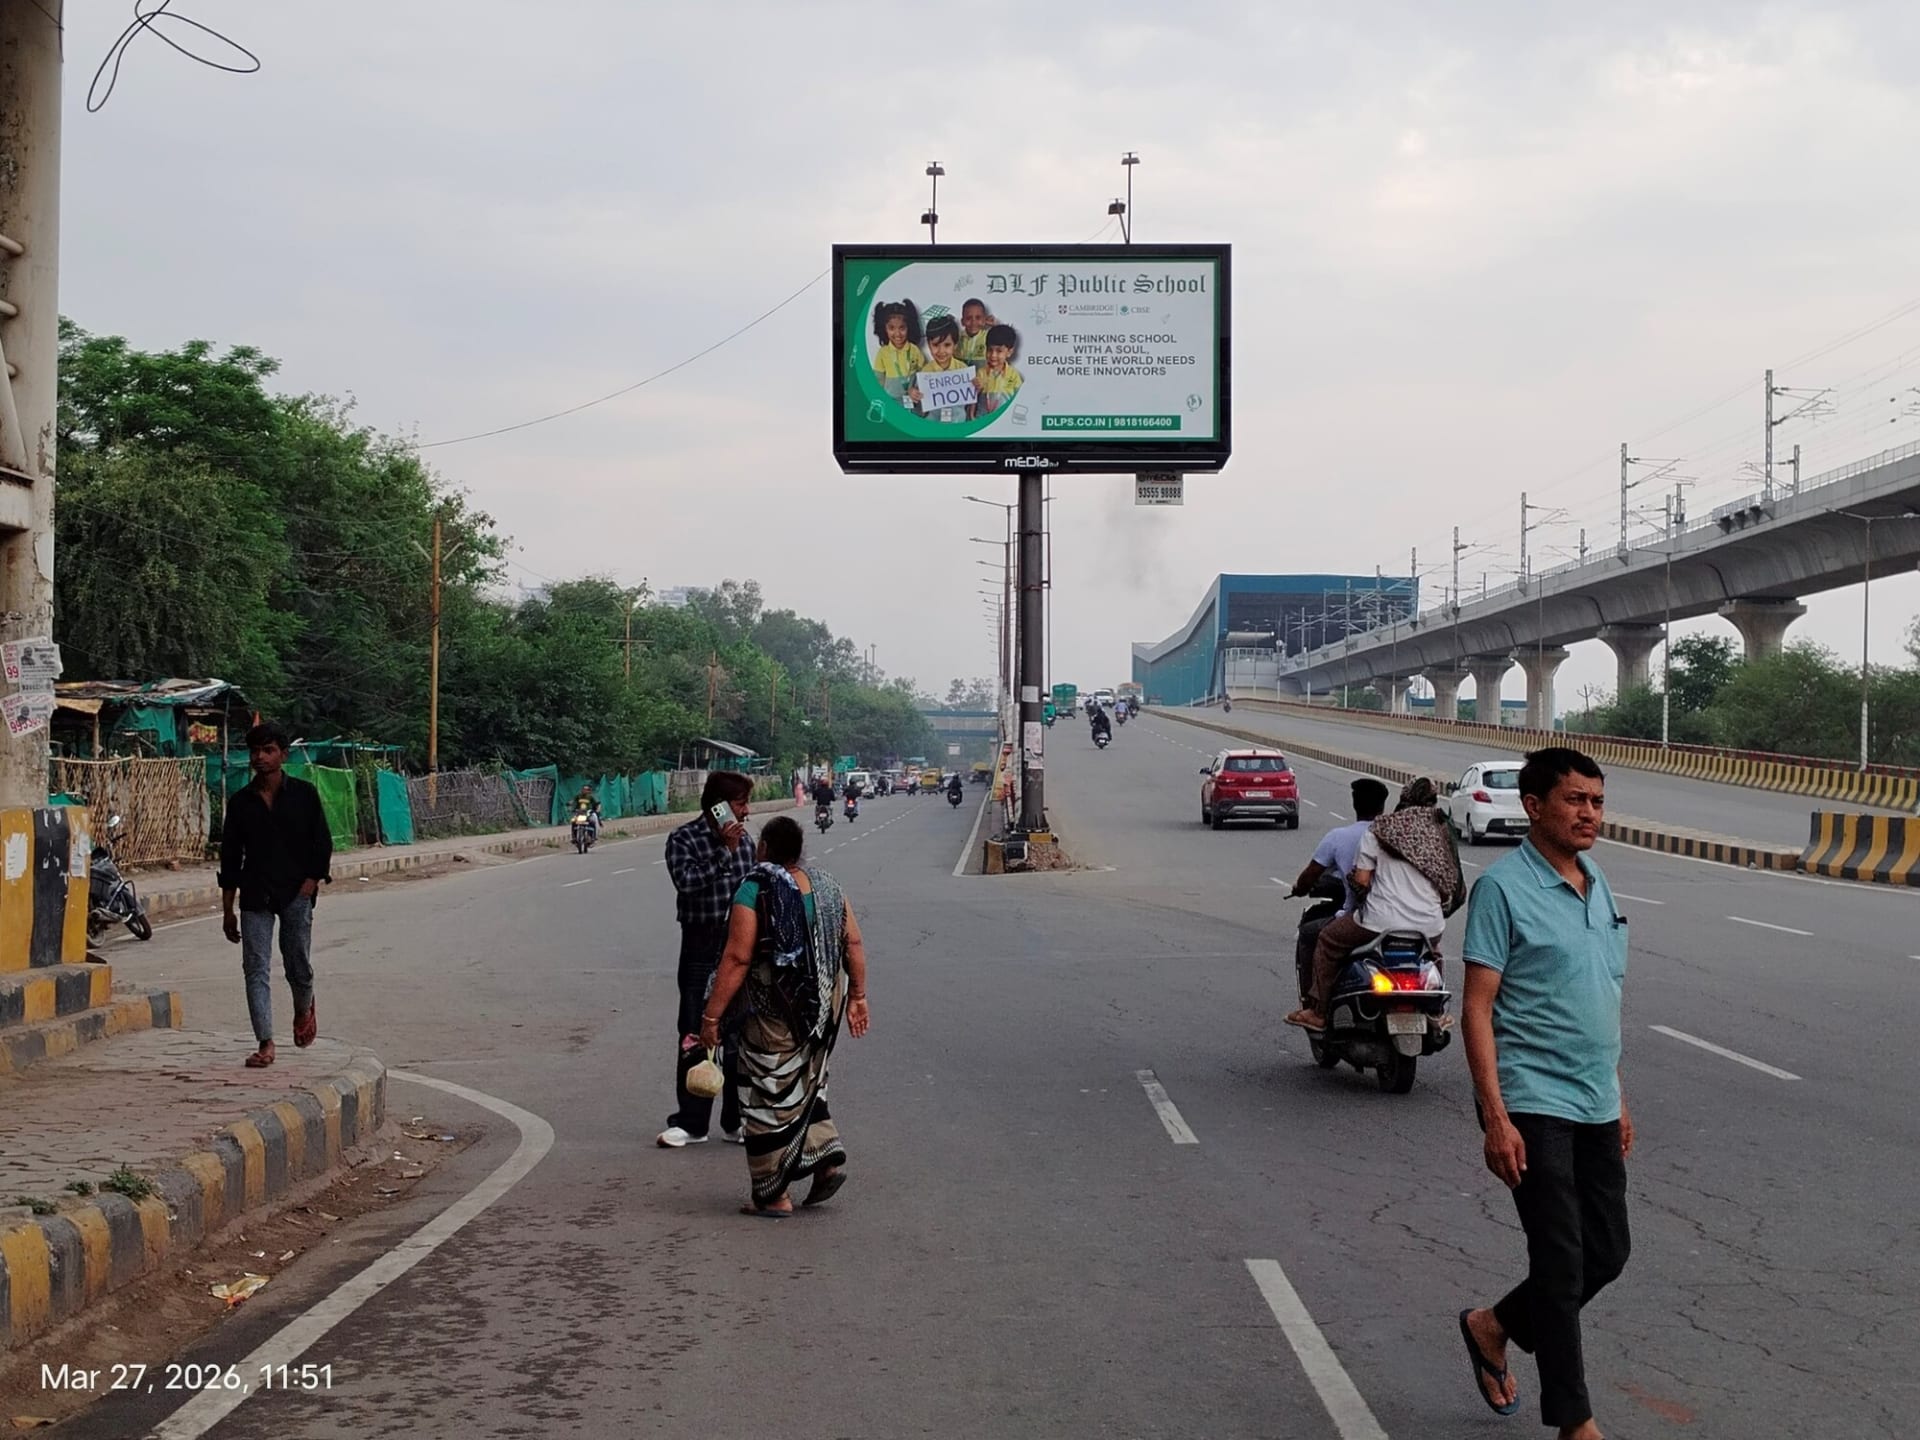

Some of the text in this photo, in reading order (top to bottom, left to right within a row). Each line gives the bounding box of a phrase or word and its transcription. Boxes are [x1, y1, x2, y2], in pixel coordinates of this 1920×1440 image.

[987, 274, 1206, 297] DLF Public School
[1069, 304, 1114, 312] CAMBRIDGE
[1046, 334, 1177, 343] THE THINKING SCHOOL
[1073, 345, 1102, 354] WITH
[1105, 345, 1113, 354] A
[1028, 356, 1196, 365] BECAUSE THE WORLD NEEDS
[1057, 367, 1167, 376] MORE INNOVATORS
[928, 373, 973, 390] ENROLL
[1046, 418, 1106, 426] DLPS.CO.IN
